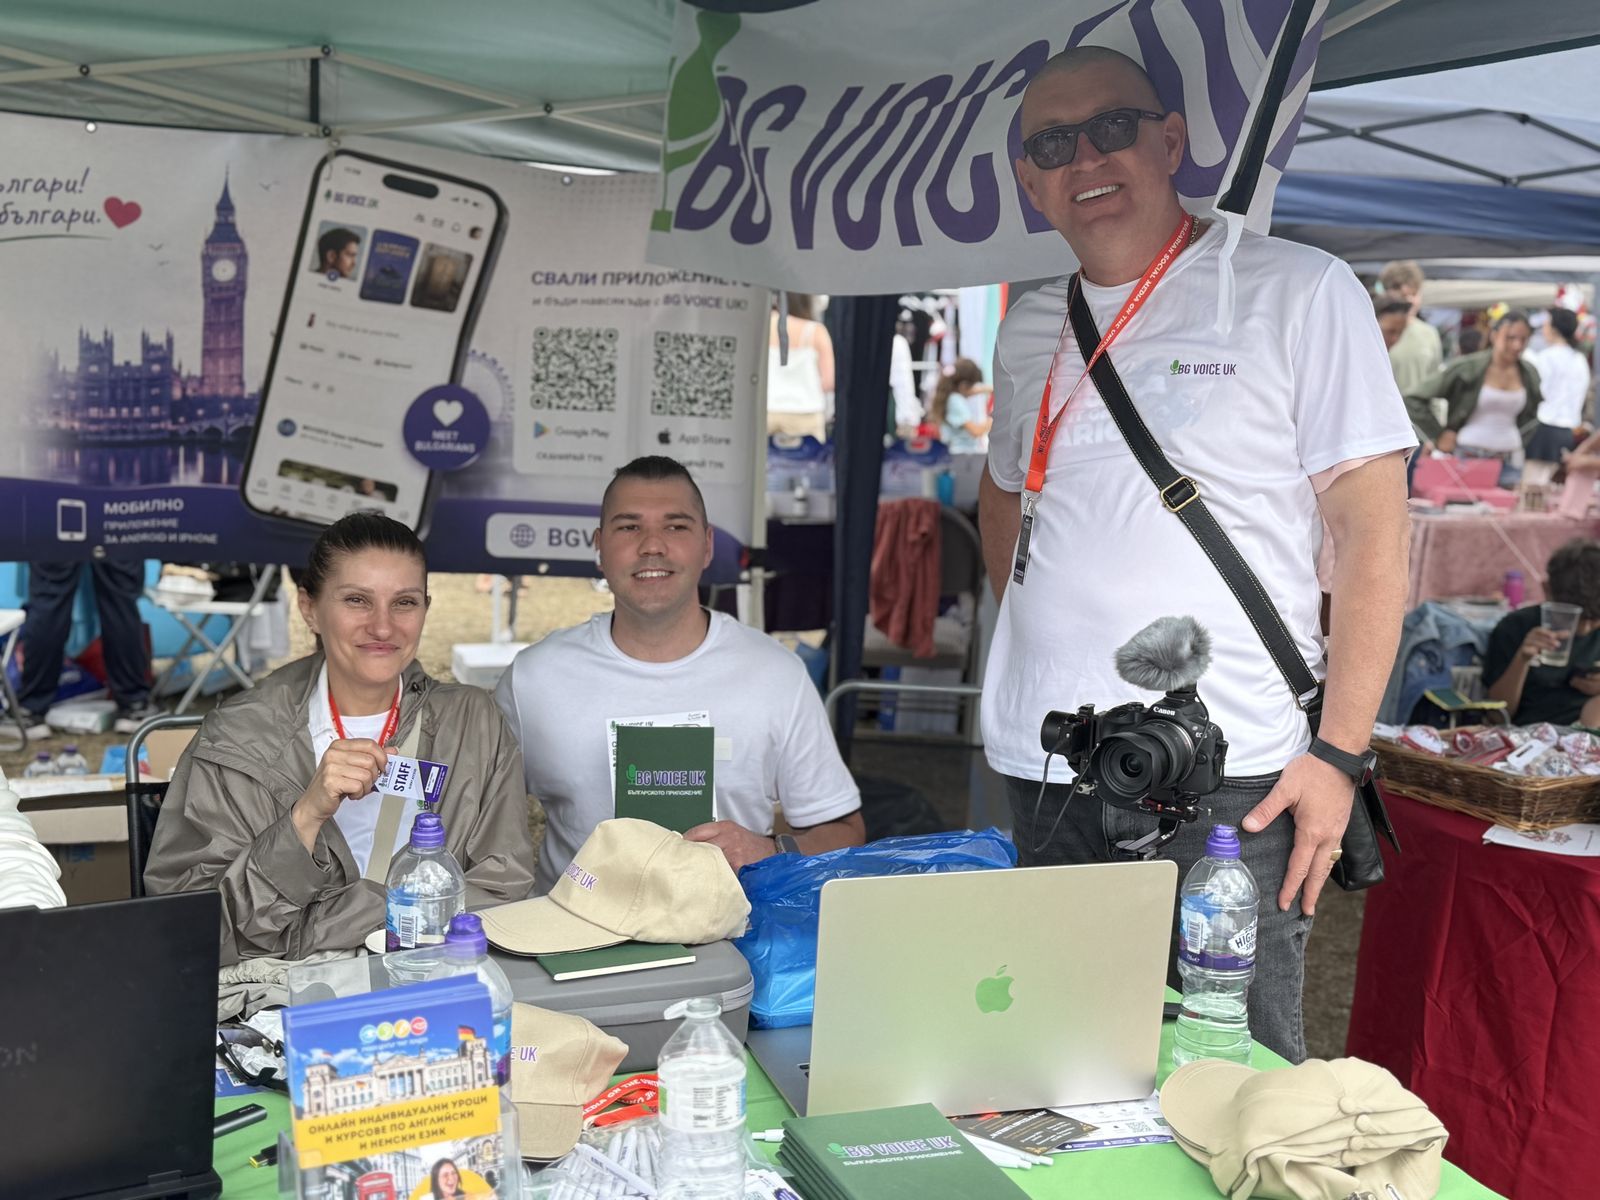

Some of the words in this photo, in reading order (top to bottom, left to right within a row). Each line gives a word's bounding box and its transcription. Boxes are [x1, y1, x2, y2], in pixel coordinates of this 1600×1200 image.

[674, 74, 804, 246] BG
[0, 167, 90, 201] лгари!
[1149, 253, 1171, 281] SOCIAL
[531, 271, 597, 287] СВАЛИ
[684, 294, 723, 309] VOICE
[1133, 280, 1152, 303] MEDIA
[1125, 302, 1136, 316] ON
[1115, 314, 1128, 331] THE
[1177, 364, 1190, 375] BG
[1193, 363, 1220, 376] VOICE
[1222, 363, 1237, 375] UK
[104, 498, 184, 515] МОБИЛНО
[548, 528, 596, 548] BGV
[1153, 705, 1176, 717] Canon
[393, 761, 411, 792] STAFF
[635, 770, 651, 786] BG
[653, 770, 688, 786] VOICE
[688, 770, 707, 786] UK
[579, 871, 597, 891] UK
[520, 1046, 538, 1062] UK
[607, 1086, 621, 1099] ON
[309, 1117, 356, 1136] ОНЛАЙН
[359, 1102, 449, 1127] ИНДИВИДУАЛНИ
[451, 1095, 488, 1109] УРОЦИ
[325, 1136, 333, 1144] И
[336, 1126, 387, 1143] КУРСОВЕ
[390, 1122, 406, 1132] ПО
[409, 1110, 475, 1129] АНГЛИЙСКИ
[360, 1142, 367, 1150] И
[370, 1134, 416, 1149] НЕМСКИ
[419, 1127, 446, 1140] ЕЗИК
[842, 1144, 874, 1158] BG
[870, 1139, 932, 1156] VOICE
[927, 1135, 961, 1149] UK
